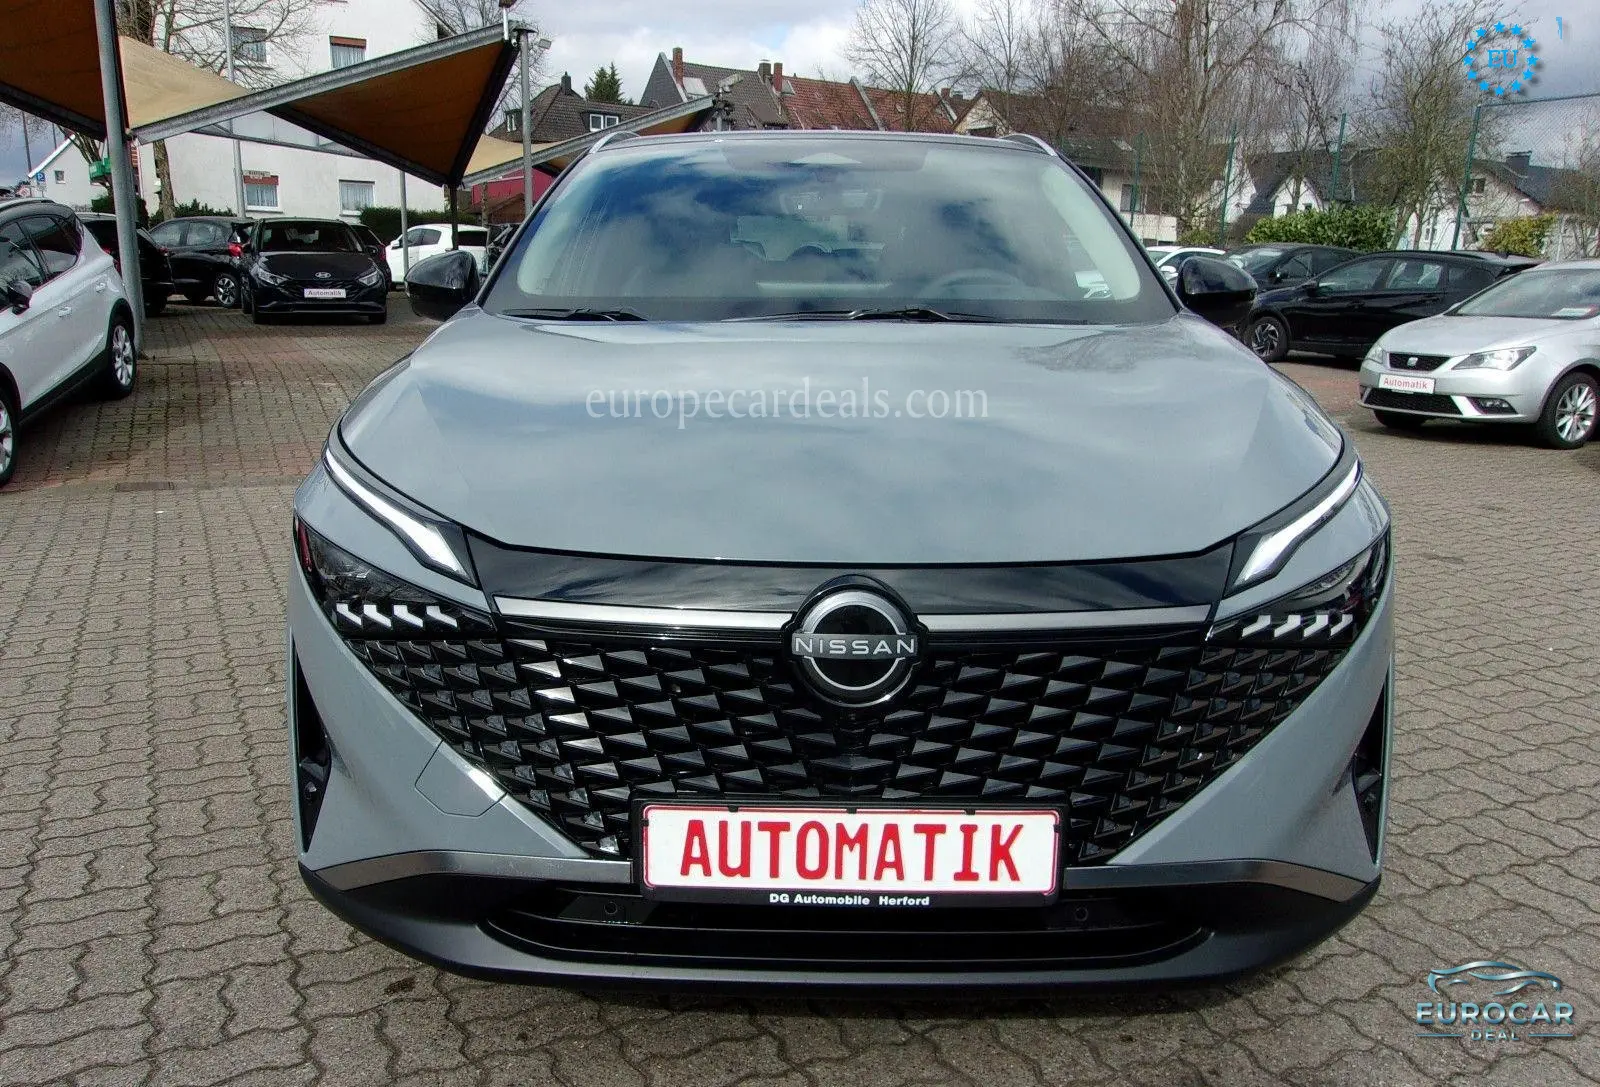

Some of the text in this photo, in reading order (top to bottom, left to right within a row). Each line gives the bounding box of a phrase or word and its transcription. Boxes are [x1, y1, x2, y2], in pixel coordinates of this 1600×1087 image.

[1383, 377, 1428, 389] Automatik
[795, 637, 915, 655] NISSAN
[679, 819, 1025, 882] AUTOMATIK
[769, 893, 930, 906] DG Automobile Herford
